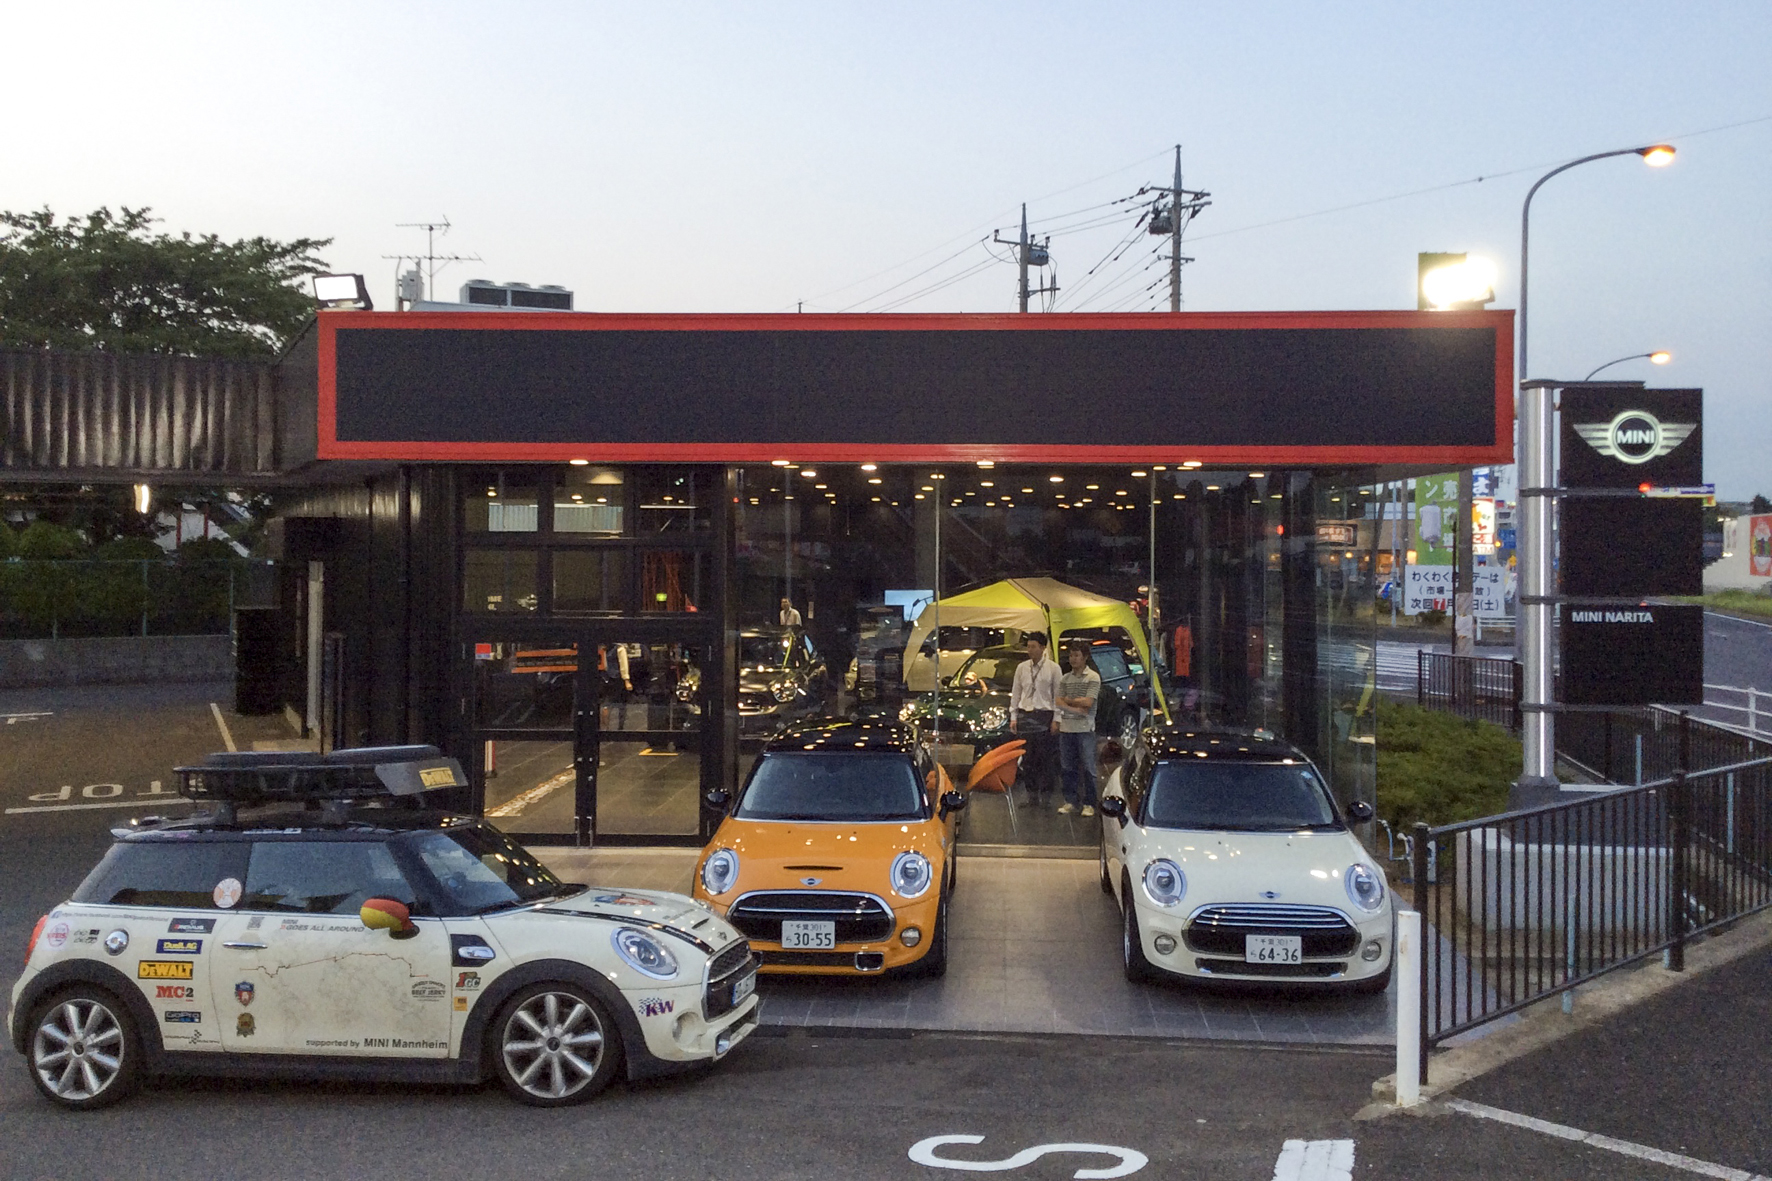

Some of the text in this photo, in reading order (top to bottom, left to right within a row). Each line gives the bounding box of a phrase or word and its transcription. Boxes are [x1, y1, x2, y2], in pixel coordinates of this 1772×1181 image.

[1616, 430, 1655, 444] MINI
[1572, 611, 1654, 623] MINI NARITA
[793, 932, 832, 946] 30-55
[1258, 947, 1298, 962] 64-36
[155, 985, 194, 998] MC2
[646, 1000, 675, 1017] KW
[306, 1037, 448, 1049] supported by MINI Mannheim
